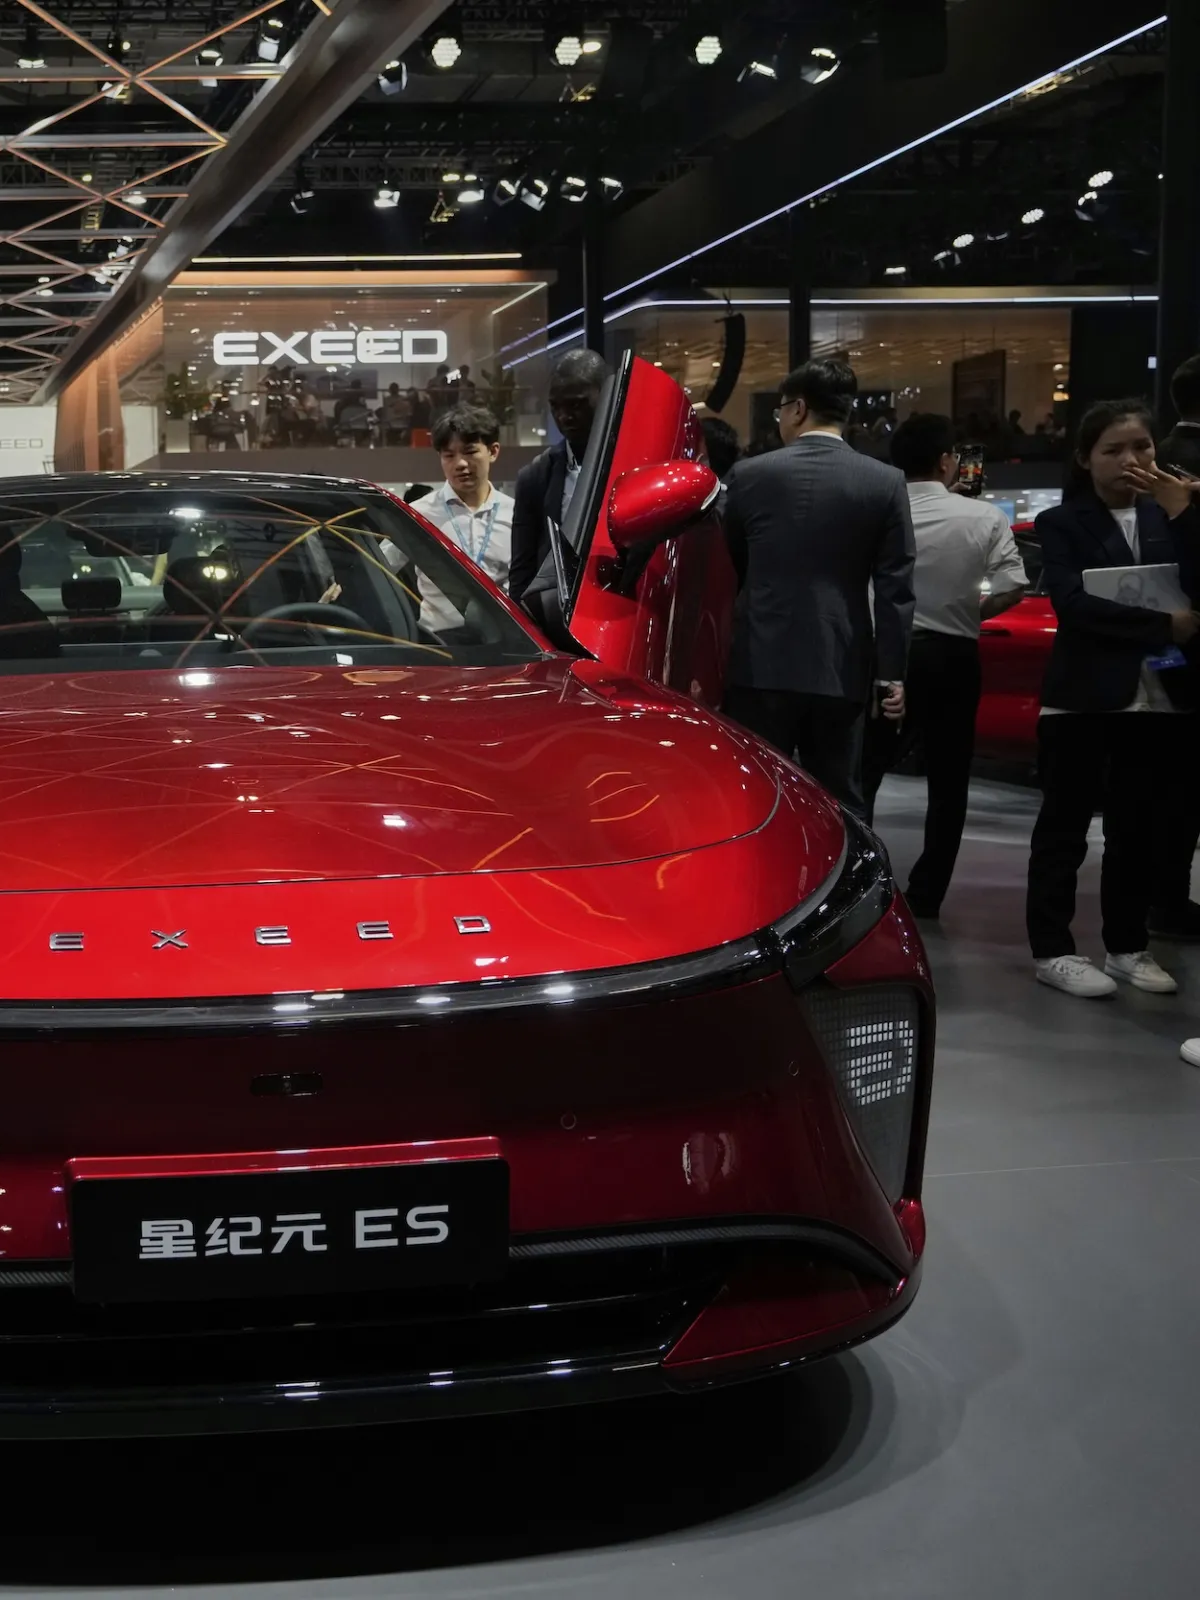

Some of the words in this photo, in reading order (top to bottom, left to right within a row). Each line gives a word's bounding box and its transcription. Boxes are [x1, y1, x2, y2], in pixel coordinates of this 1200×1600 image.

[213, 329, 448, 366] EXEED
[49, 914, 492, 951] EXEED
[139, 1213, 328, 1259] 星纪元
[355, 1204, 450, 1249] ES
